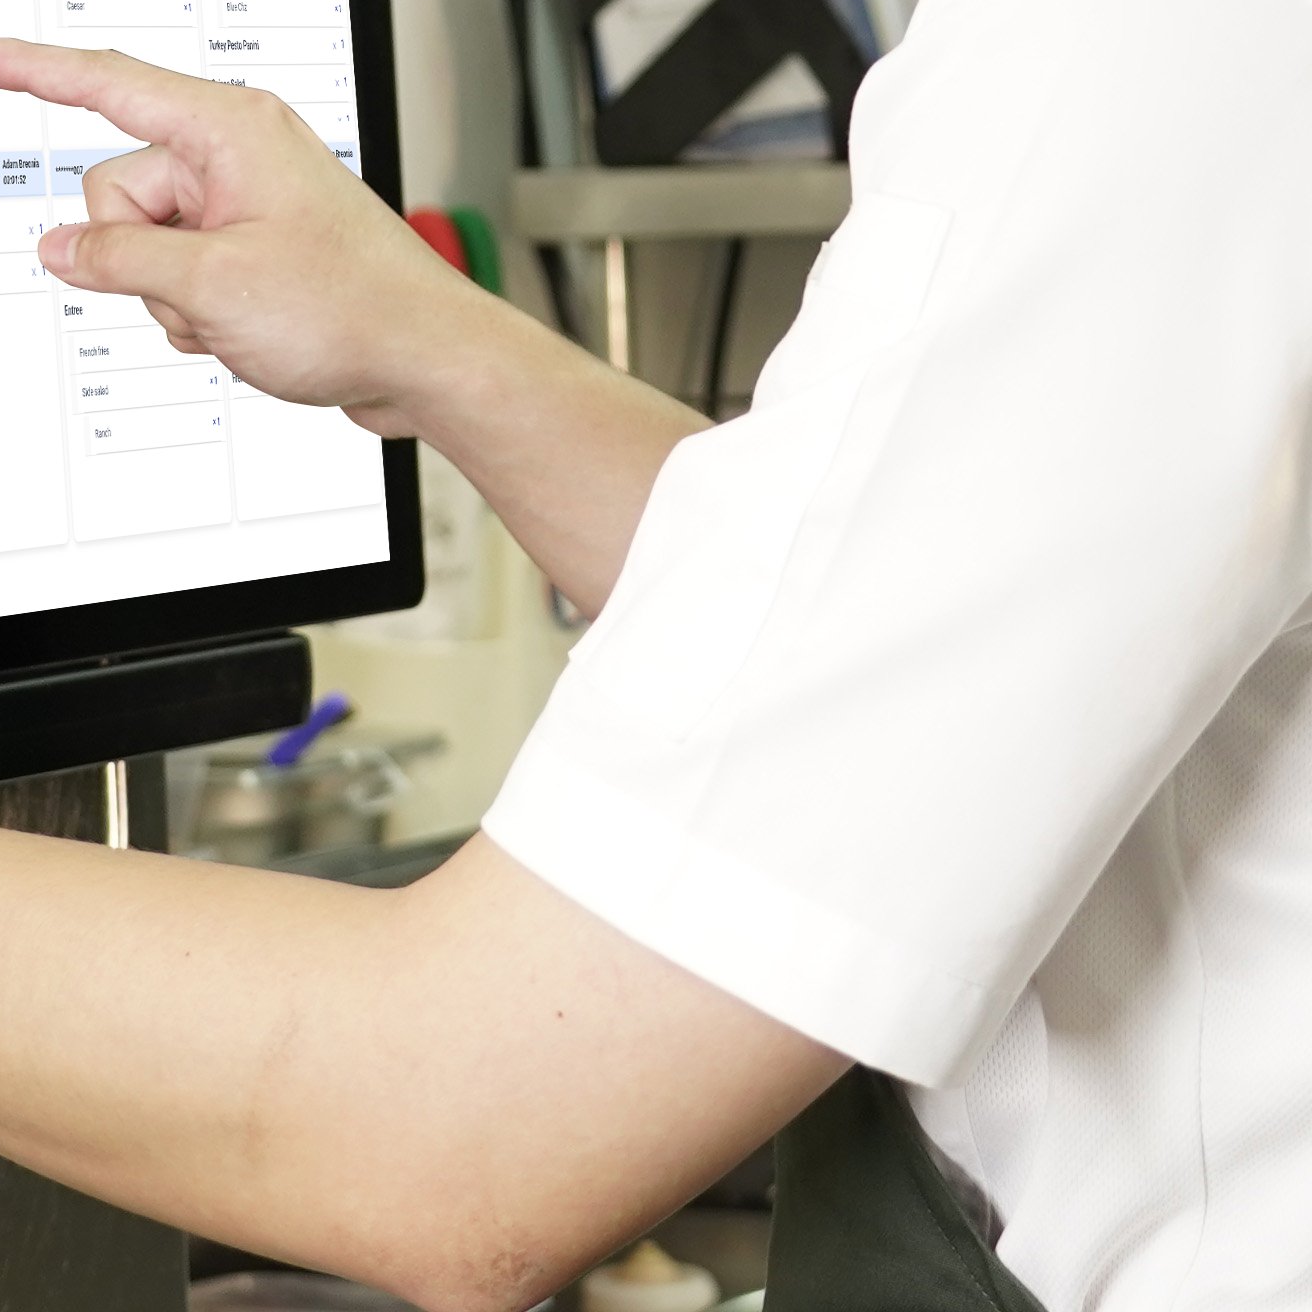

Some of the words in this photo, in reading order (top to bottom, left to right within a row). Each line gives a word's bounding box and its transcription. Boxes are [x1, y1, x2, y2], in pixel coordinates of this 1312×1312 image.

[209, 40, 226, 52] Turkey
[227, 40, 241, 50] Pesto
[242, 40, 259, 50] Panini
[2, 159, 17, 169] Adam
[64, 305, 83, 316] Entree
